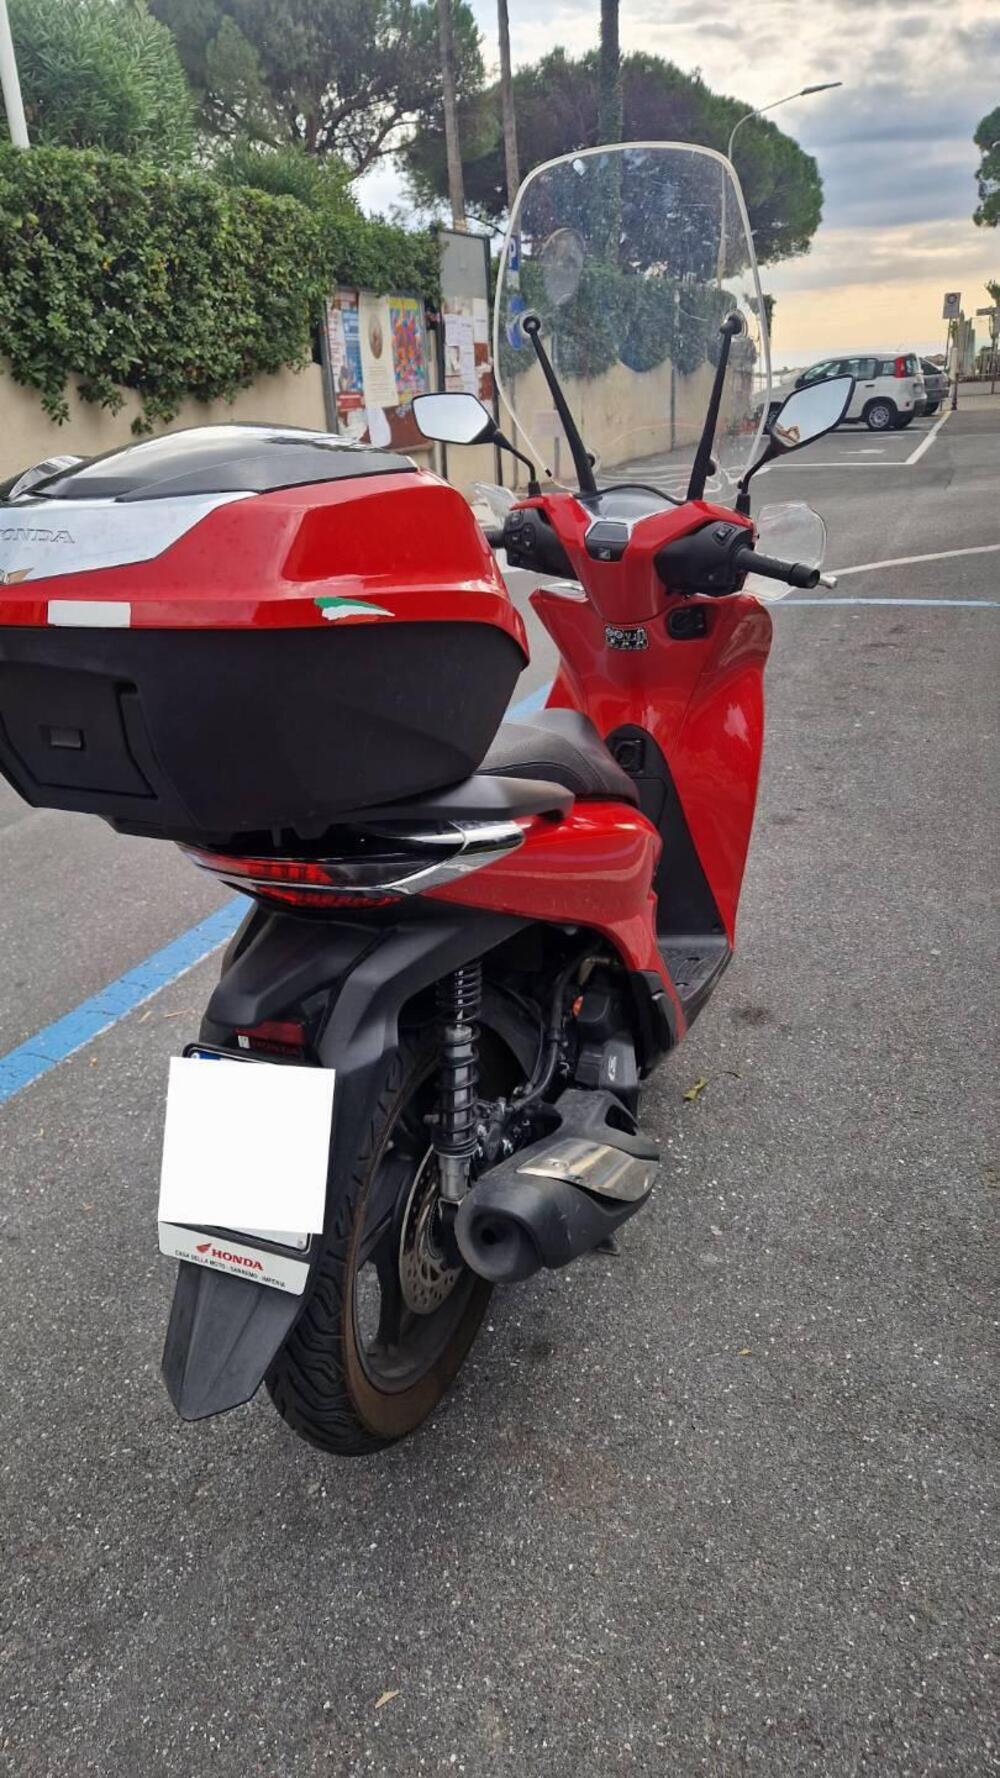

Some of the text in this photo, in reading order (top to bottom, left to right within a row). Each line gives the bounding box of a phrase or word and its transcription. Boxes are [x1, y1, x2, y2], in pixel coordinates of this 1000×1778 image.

[0, 528, 76, 544] ONDA
[175, 1249, 190, 1258] CASA
[191, 1253, 208, 1264] DELLA
[209, 1258, 226, 1269] MOTO
[211, 1248, 264, 1271] HONDA
